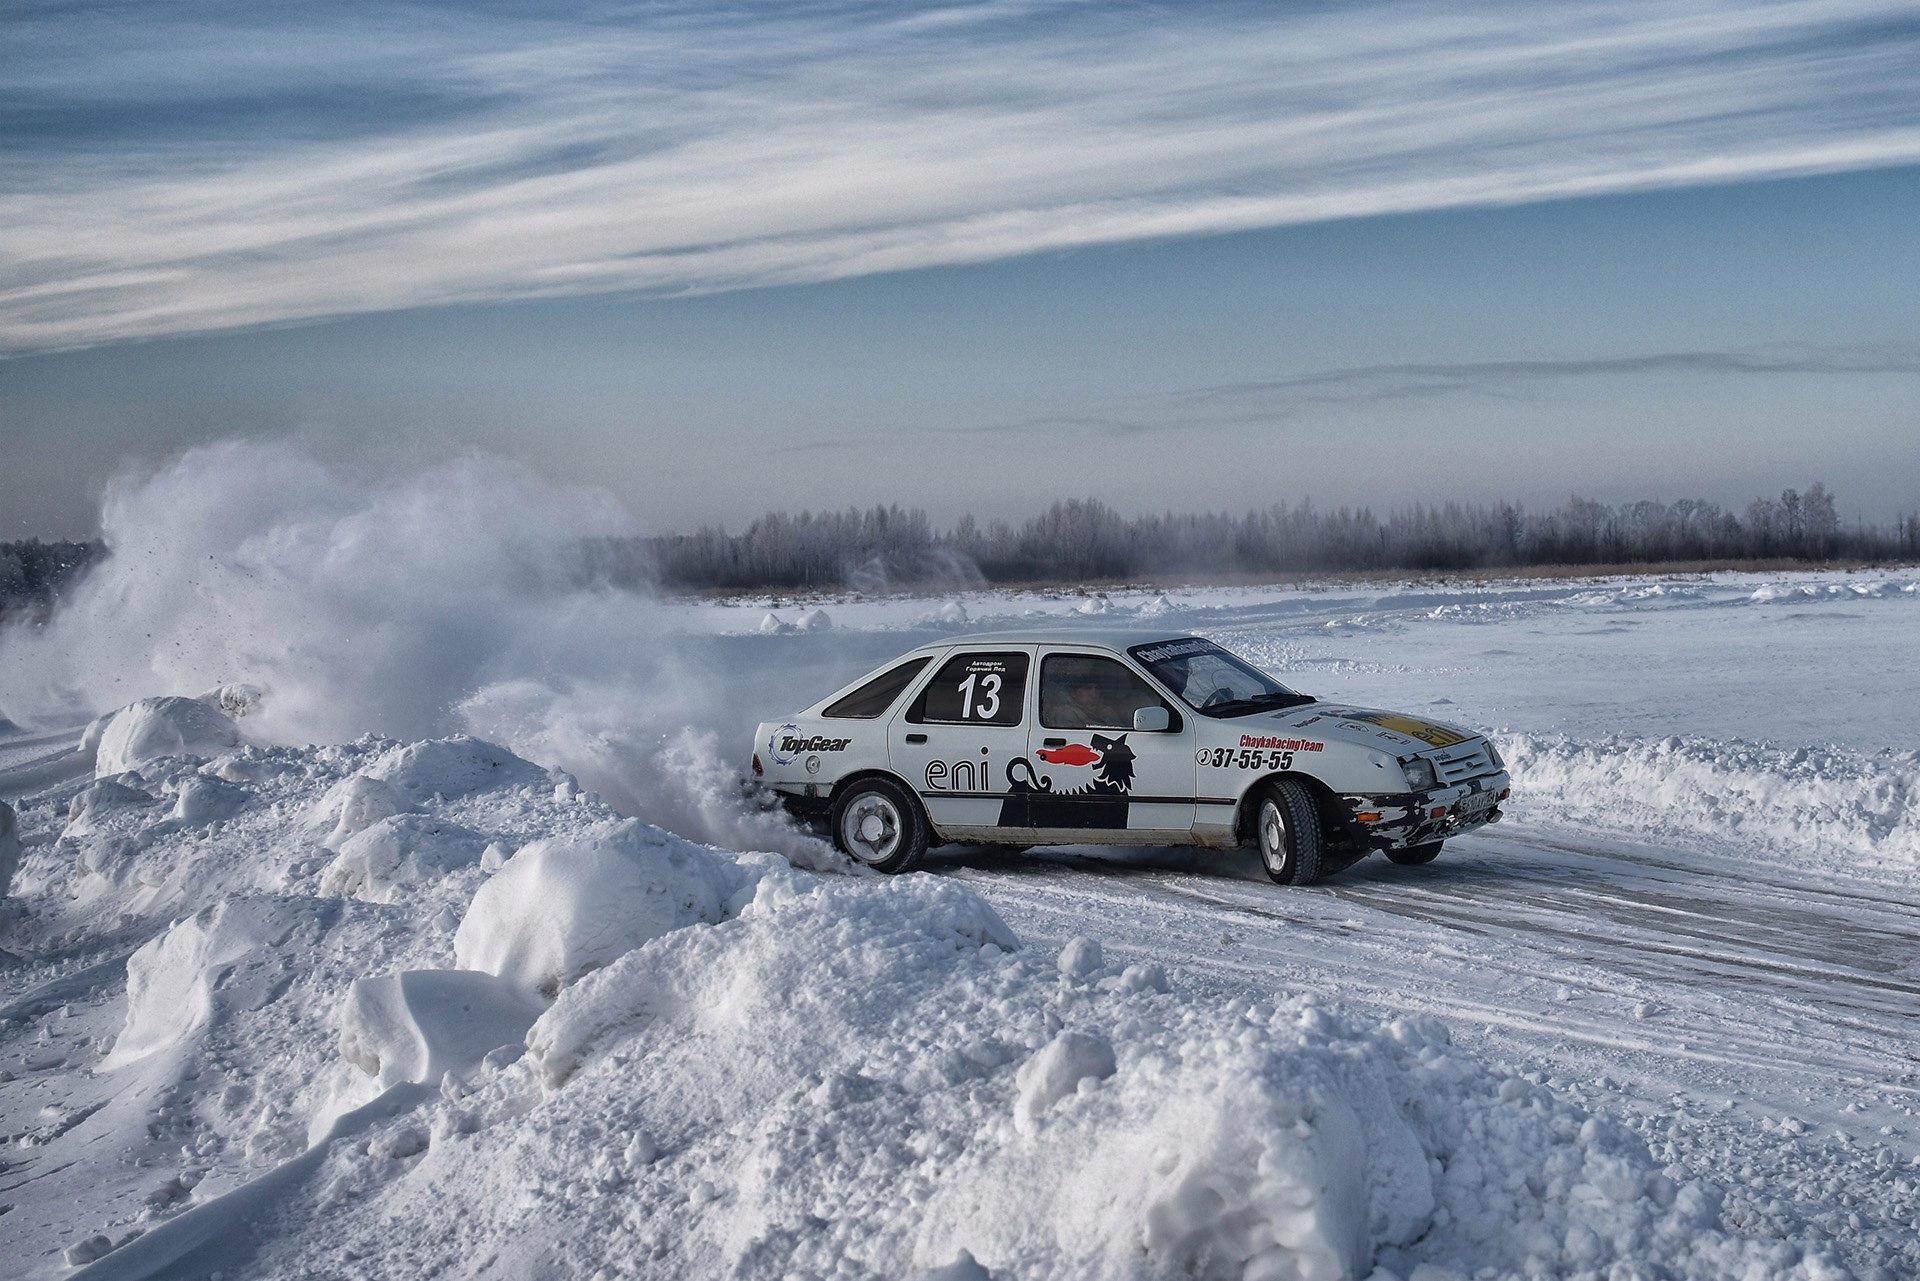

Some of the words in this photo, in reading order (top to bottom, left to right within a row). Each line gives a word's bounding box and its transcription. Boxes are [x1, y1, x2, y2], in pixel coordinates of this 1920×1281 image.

[958, 673, 1002, 719] 13
[780, 735, 852, 755] TopGear
[1239, 734, 1324, 753] ChaykaRacingTeam
[924, 746, 990, 791] eni
[1211, 747, 1294, 770] 37-55-55
